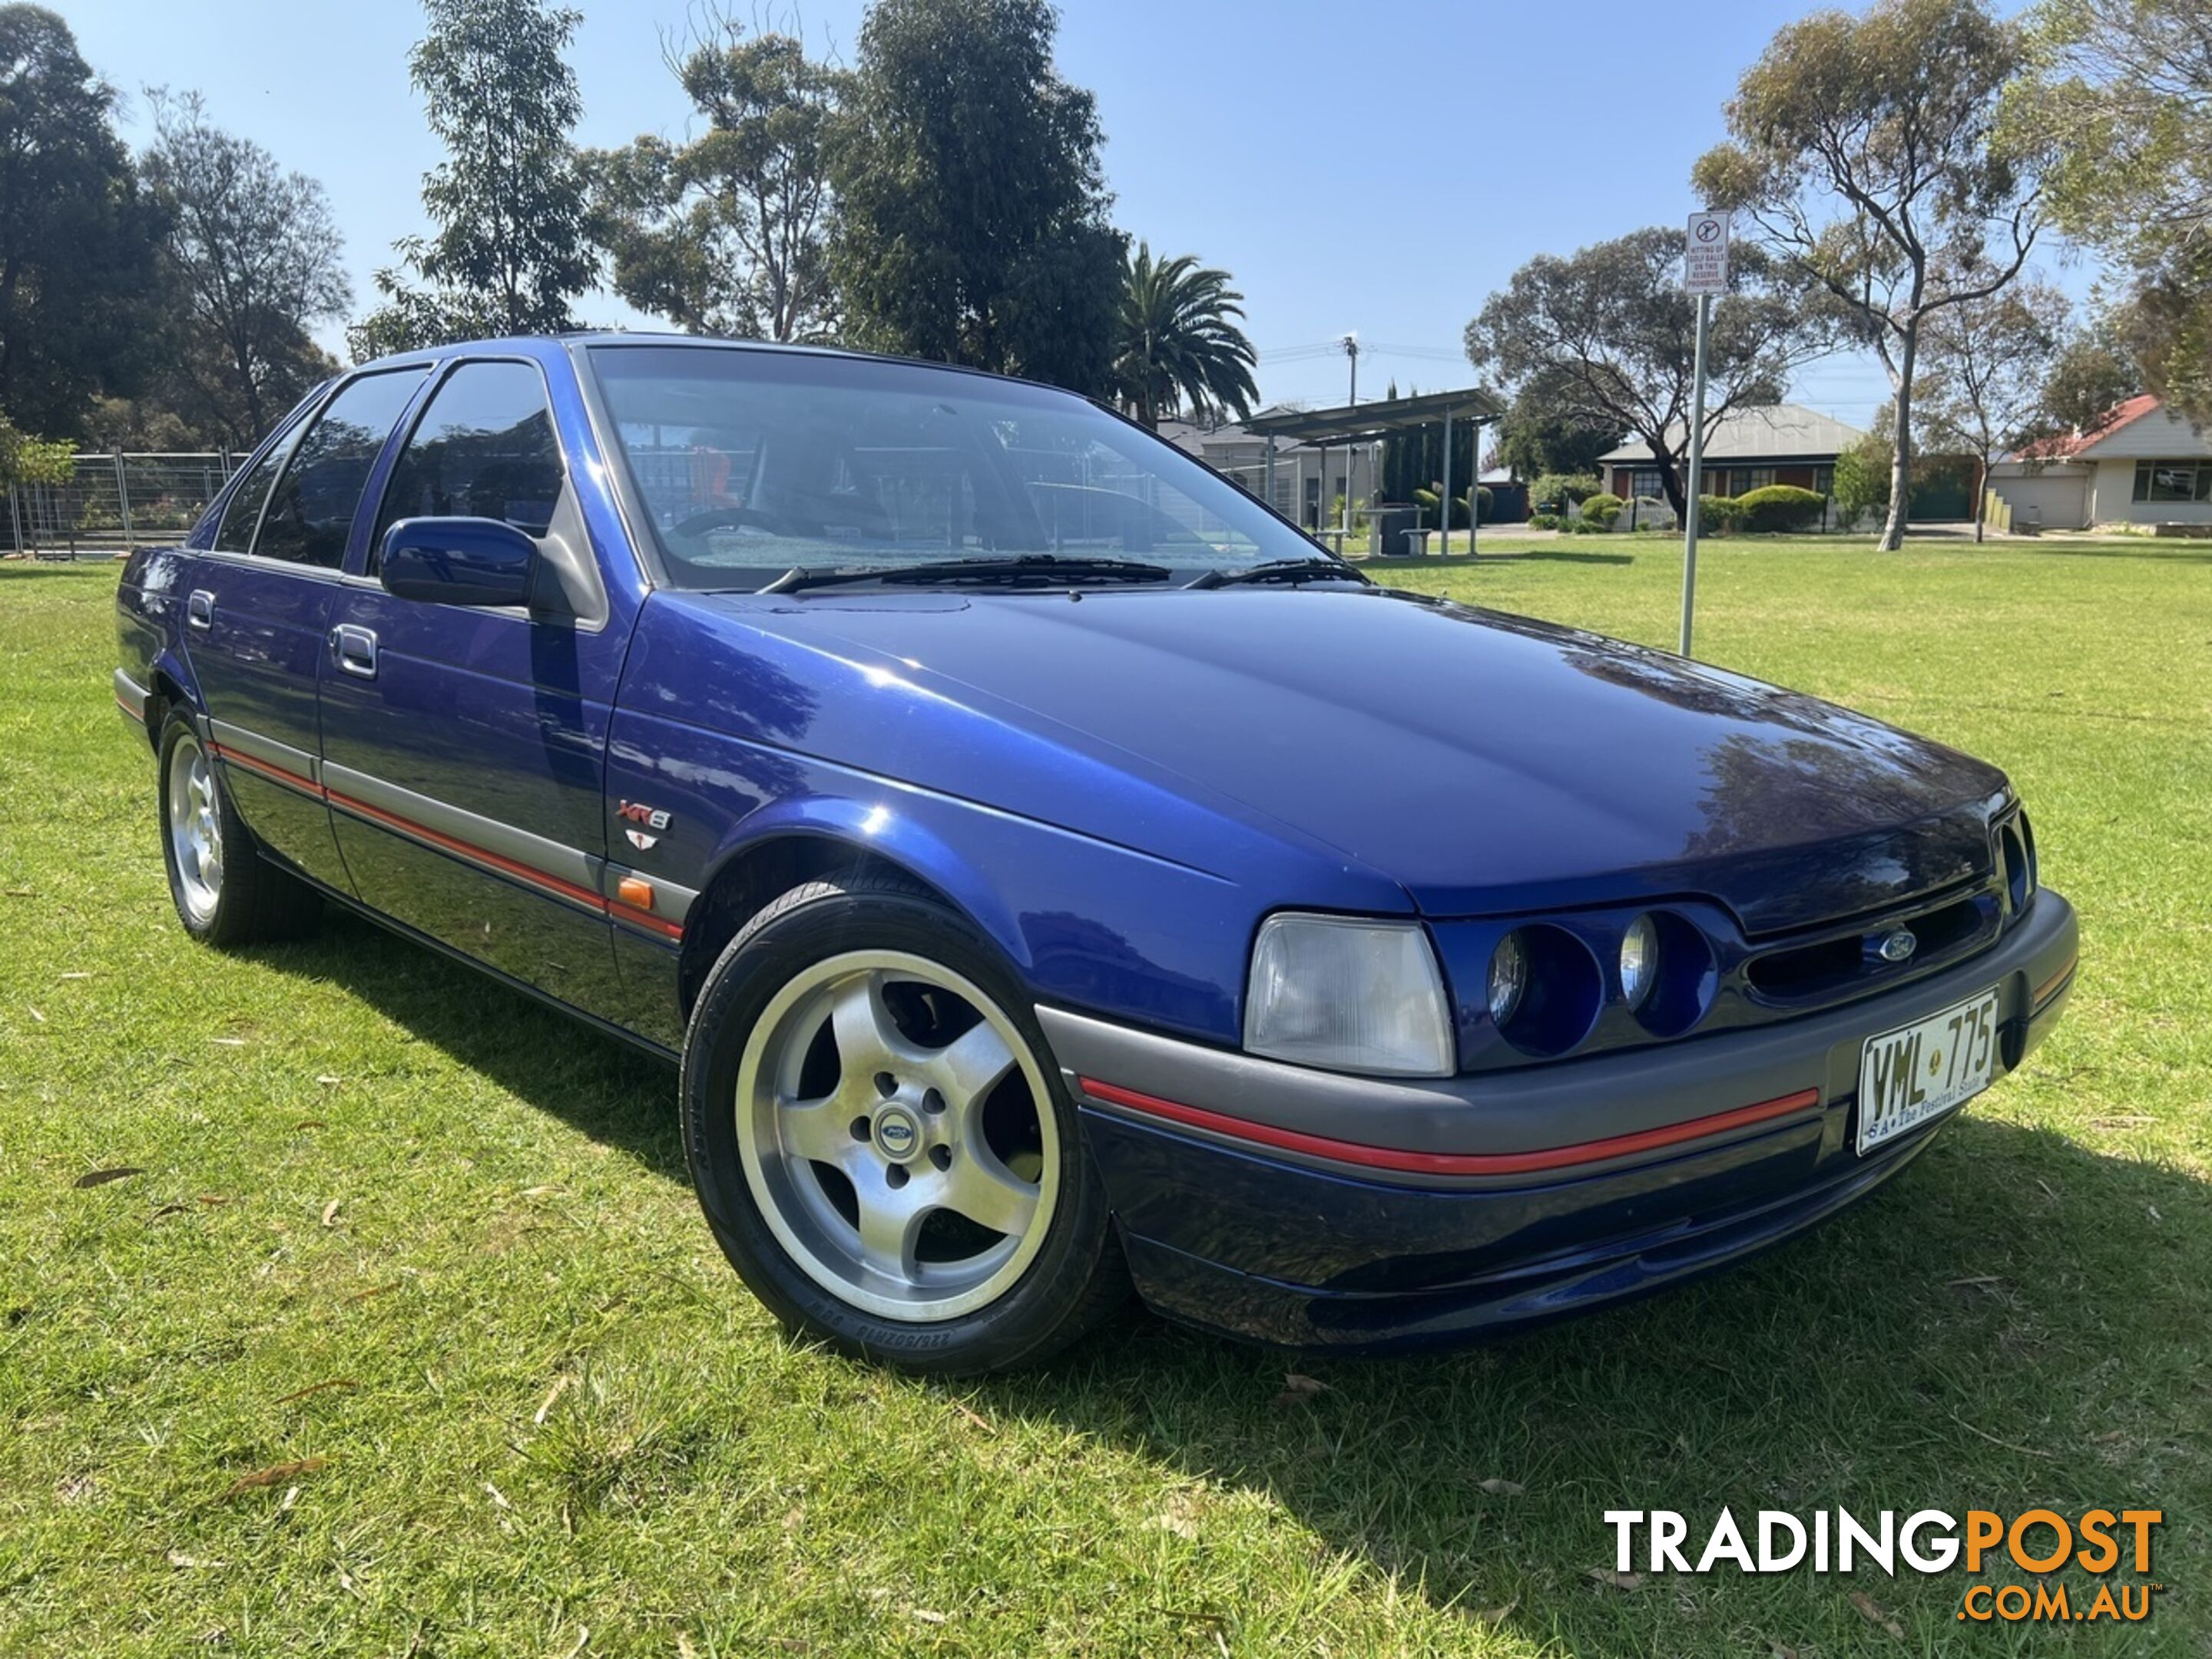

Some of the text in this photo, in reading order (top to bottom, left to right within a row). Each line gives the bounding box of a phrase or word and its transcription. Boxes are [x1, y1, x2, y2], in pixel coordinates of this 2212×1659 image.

[615, 800, 672, 830] XR8
[1873, 999, 1994, 1121] VML 775
[1899, 1108, 1918, 1127] The
[1920, 1085, 1957, 1118] Festival
